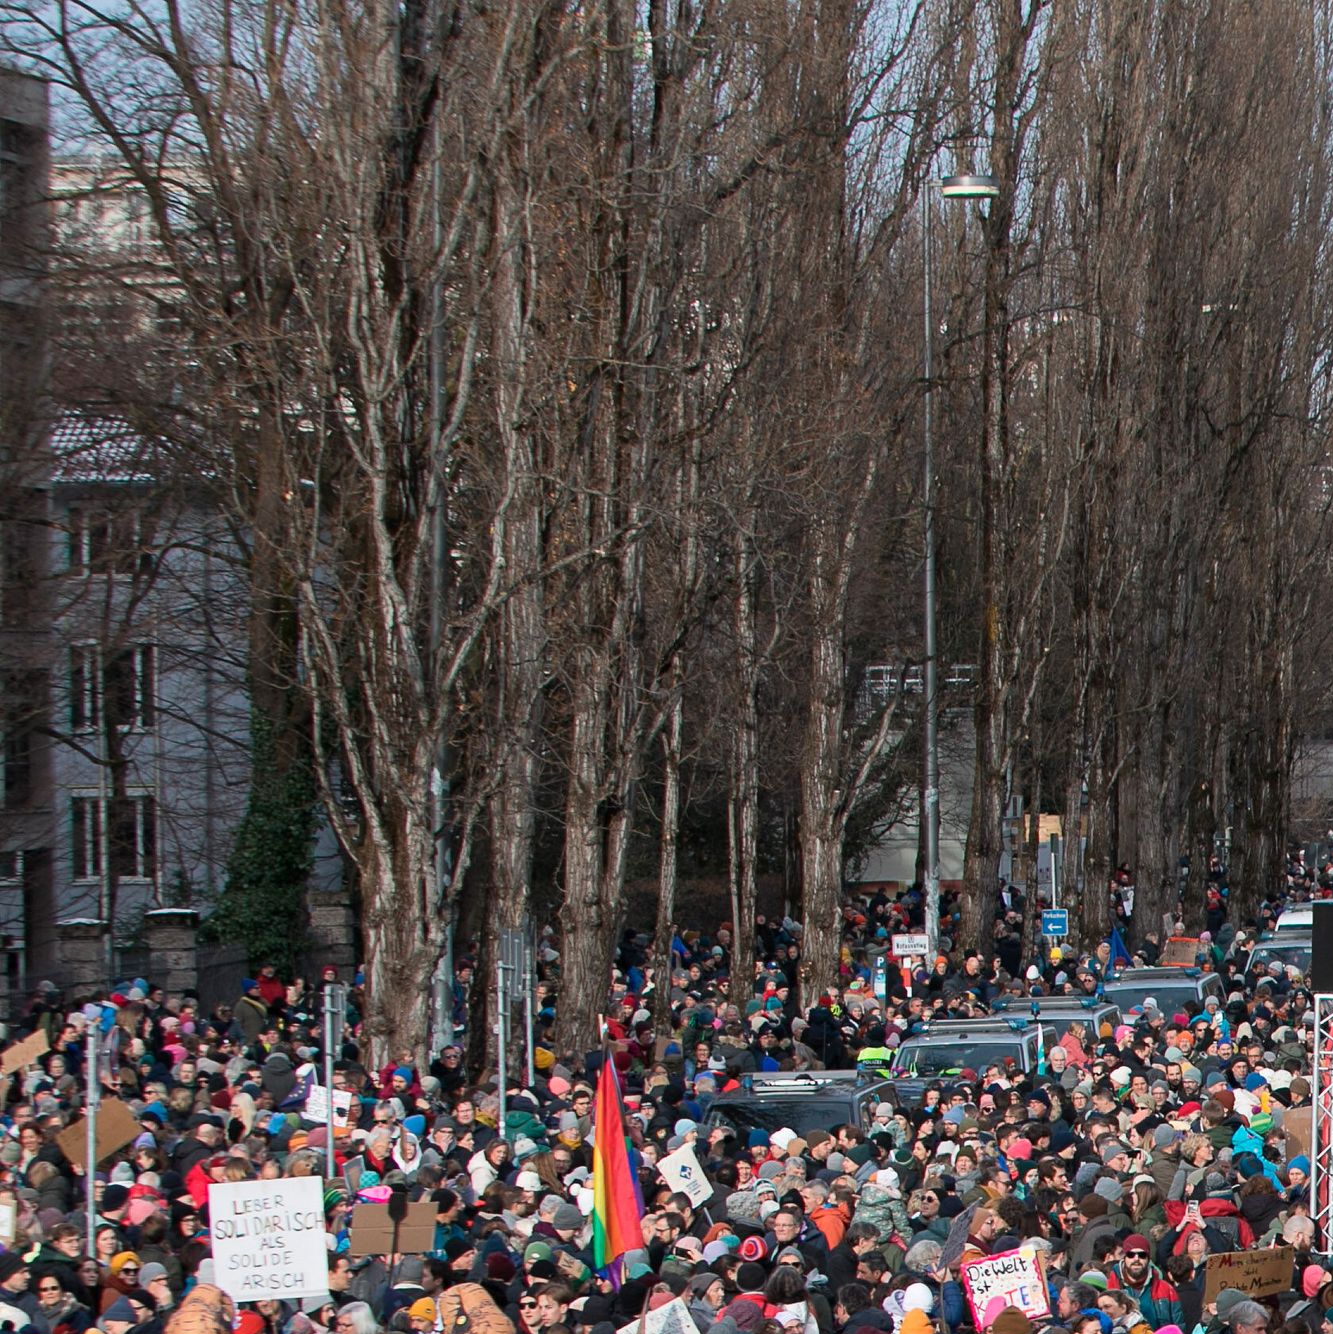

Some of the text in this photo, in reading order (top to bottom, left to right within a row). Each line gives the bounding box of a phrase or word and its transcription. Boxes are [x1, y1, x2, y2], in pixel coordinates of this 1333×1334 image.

[260, 1236, 286, 1250] ALS
[228, 1250, 294, 1271] SOLIDE
[991, 1257, 1027, 1276] Welt
[241, 1272, 305, 1291] ARISCH
